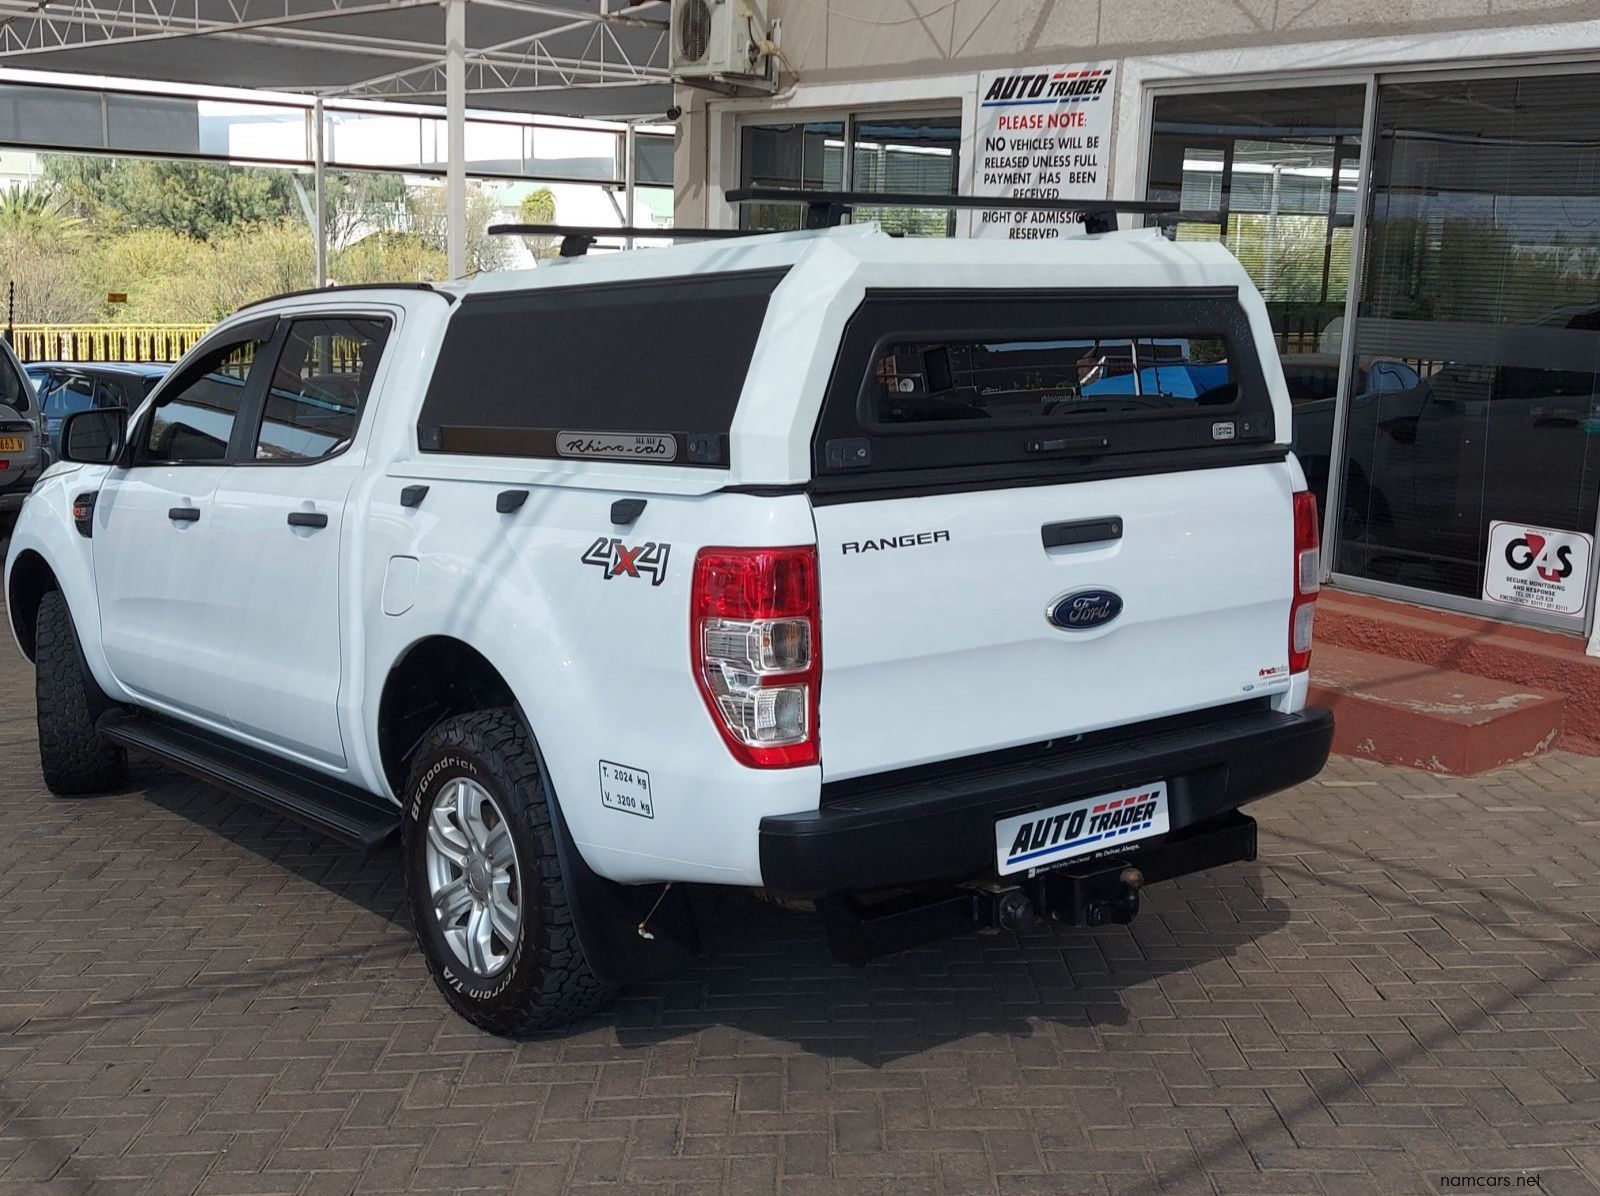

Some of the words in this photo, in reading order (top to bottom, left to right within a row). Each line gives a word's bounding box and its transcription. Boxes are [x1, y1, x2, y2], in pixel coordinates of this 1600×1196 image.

[984, 74, 1050, 101] AUTO
[1047, 78, 1108, 98] TRADER
[998, 113, 1044, 130] PLEASE
[1047, 112, 1087, 128] NOTE:
[985, 137, 1006, 151] NO
[1009, 137, 1054, 151] VEHICLES
[1058, 137, 1083, 149] WILL
[1087, 136, 1099, 148] BE
[984, 156, 1029, 169] RELEASED
[1032, 155, 1071, 168] UNLESS
[1074, 154, 1098, 167] FULL
[984, 172, 1032, 185] PAYMENT
[1038, 172, 1061, 184] HAS
[1069, 171, 1097, 184] BEEN
[1013, 188, 1059, 199] RECEIVED
[982, 211, 1012, 223] RIGHT
[1014, 211, 1028, 223] OF
[1009, 228, 1059, 240] RESERVED
[841, 530, 950, 555] RANGER
[1505, 533, 1573, 583] G4S
[1506, 576, 1528, 586] SECURE
[1529, 580, 1566, 592] MONITORING
[1526, 587, 1556, 597] RESPONSE
[1500, 594, 1529, 604] EMERGENCY
[1070, 597, 1110, 622] Ford
[602, 766, 609, 778] T.
[614, 769, 633, 783] 2024
[637, 775, 647, 790] kg
[411, 757, 477, 822] BFGoodrich
[604, 790, 612, 802] V.
[617, 794, 636, 808] 3200
[640, 800, 650, 814] kg
[1008, 808, 1088, 856] AUTO
[1088, 801, 1157, 835] TRADER
[443, 966, 464, 993] T/A
